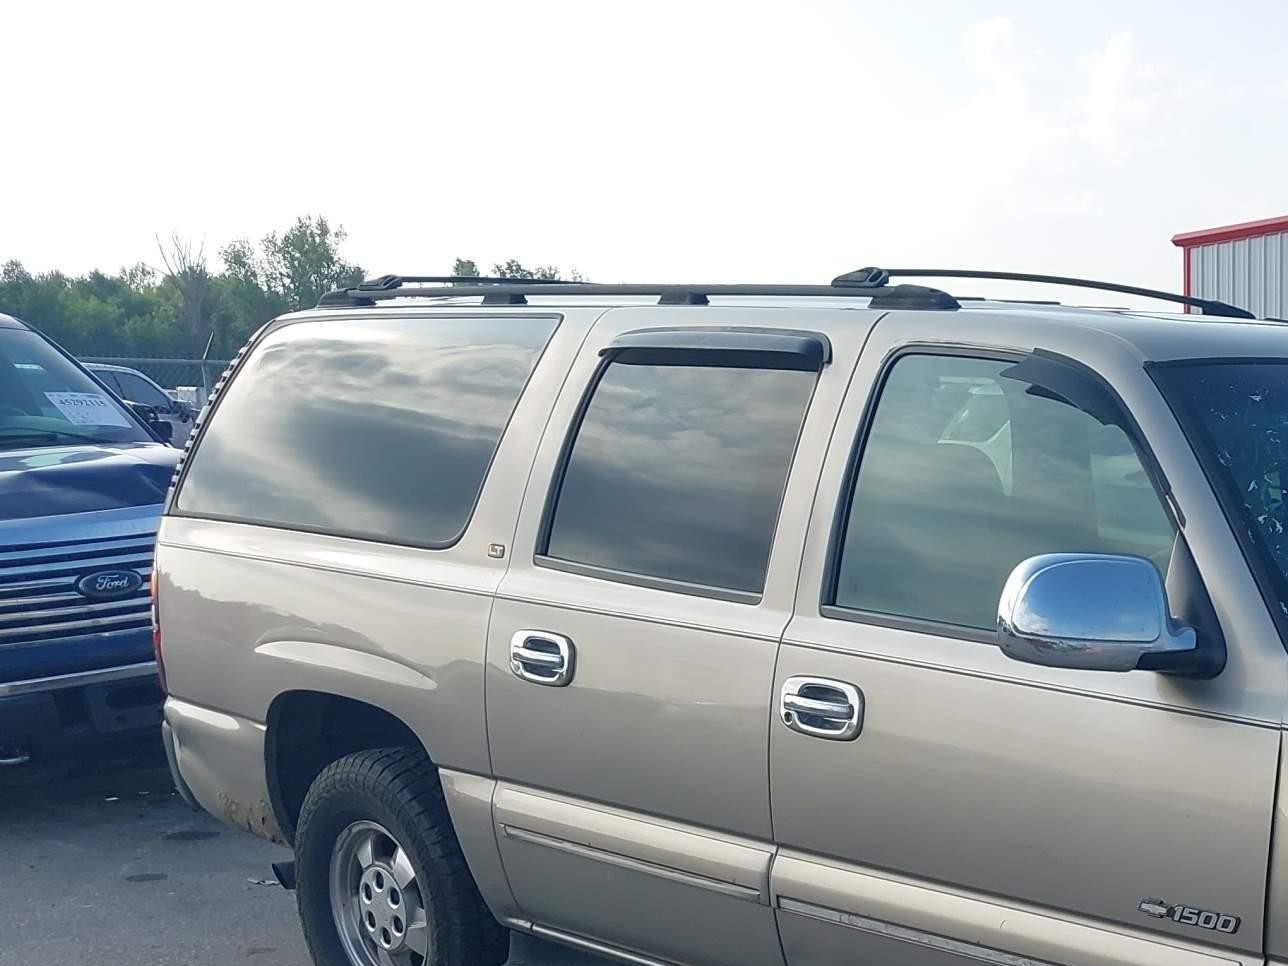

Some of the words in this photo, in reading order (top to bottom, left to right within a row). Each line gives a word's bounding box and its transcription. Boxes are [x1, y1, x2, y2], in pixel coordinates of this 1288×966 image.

[490, 545, 504, 556] LT
[95, 574, 130, 591] Ford
[1172, 904, 1240, 933] 1500
